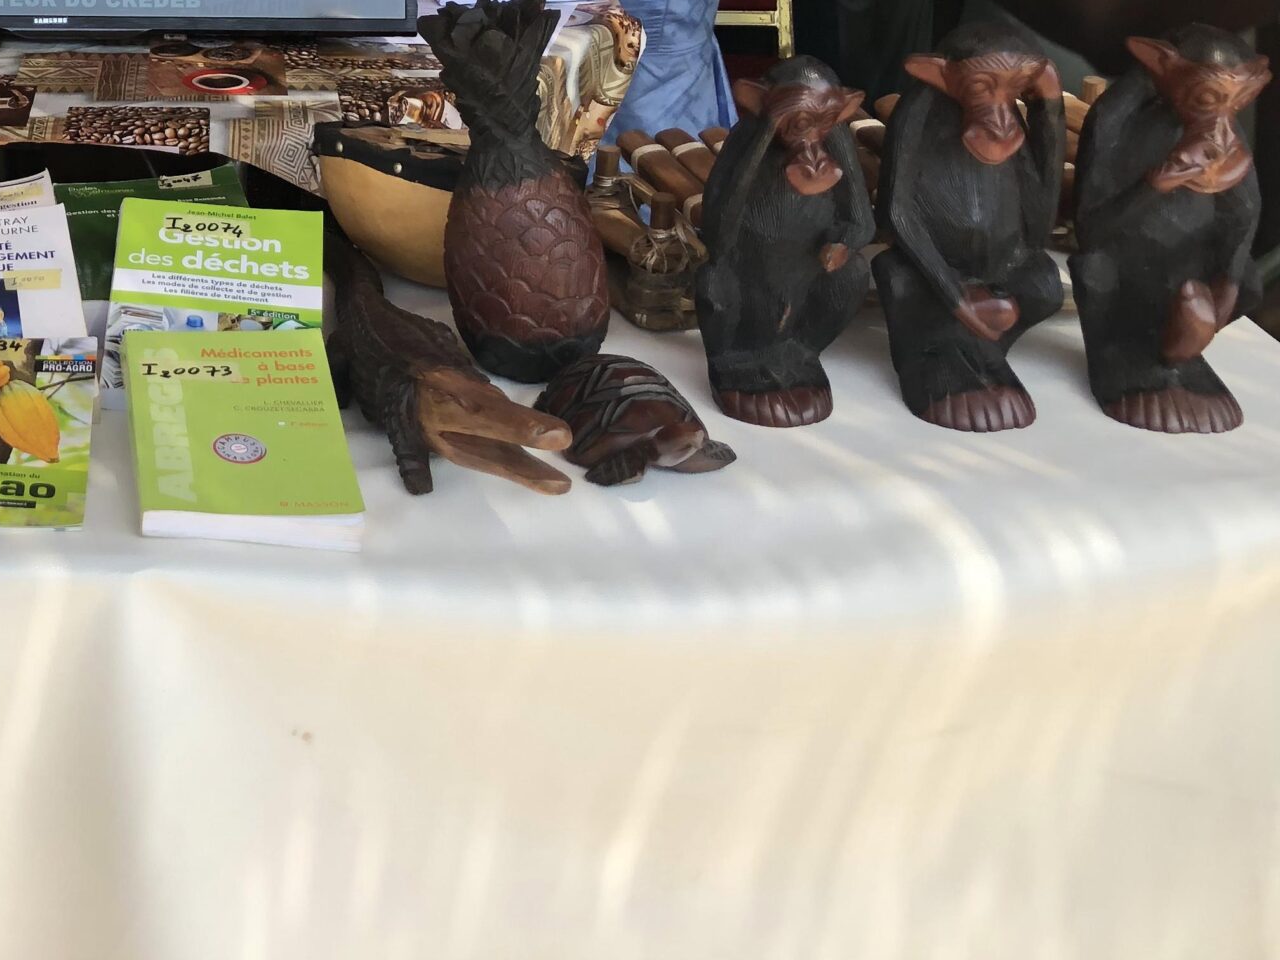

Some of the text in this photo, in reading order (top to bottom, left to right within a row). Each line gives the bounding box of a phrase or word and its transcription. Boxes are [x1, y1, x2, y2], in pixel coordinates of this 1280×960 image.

[187, 209, 234, 219] Jean-Michel
[158, 227, 282, 253] Gestion
[127, 248, 310, 281] des déchets
[152, 272, 166, 280] Les
[168, 273, 209, 283] différents
[211, 278, 234, 287] types
[249, 282, 283, 291] déchets
[142, 278, 156, 286] Les
[158, 280, 186, 288] modes
[201, 283, 234, 293] collecte
[260, 290, 293, 300] gestion
[164, 286, 178, 294] Les
[180, 287, 208, 297] filières
[224, 292, 269, 303] traitement
[262, 309, 297, 320] édition
[201, 347, 313, 359] Médicaments
[42, 363, 93, 372] PRO-AGRO
[258, 360, 316, 371] à base
[256, 373, 319, 387] plantes
